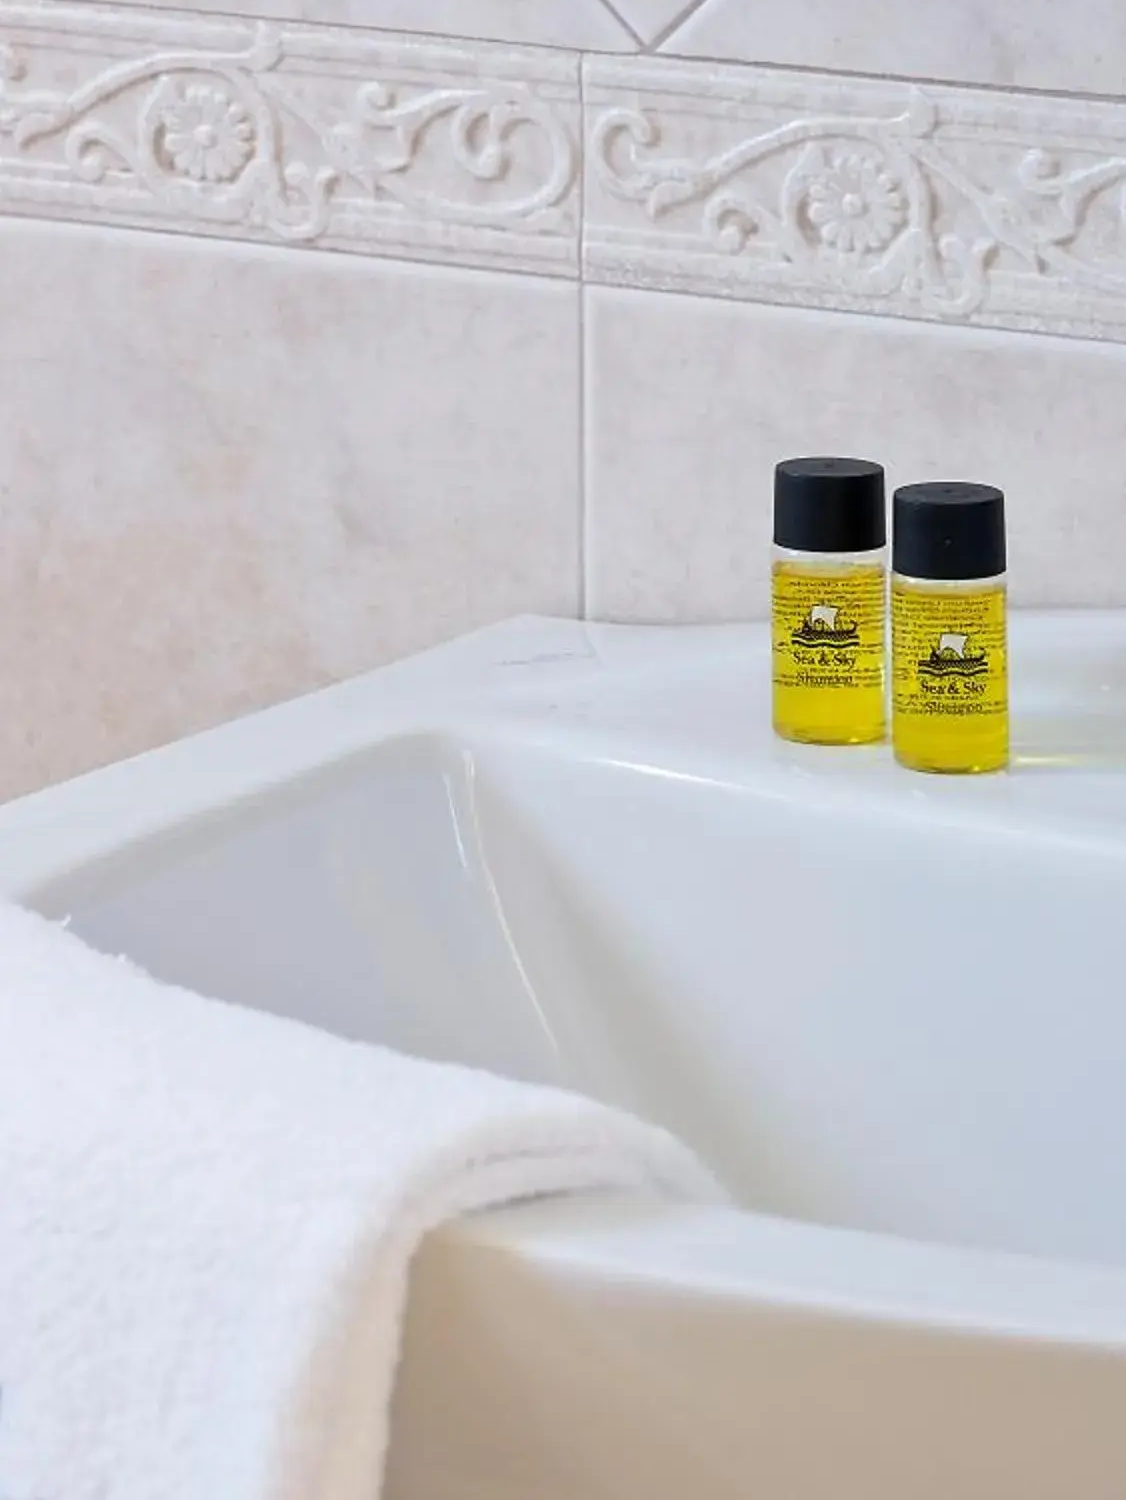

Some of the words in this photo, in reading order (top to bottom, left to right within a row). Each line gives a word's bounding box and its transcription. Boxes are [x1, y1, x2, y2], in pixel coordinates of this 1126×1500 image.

[793, 651, 815, 665] Sea
[817, 653, 831, 665] &
[832, 652, 857, 668] Sky
[920, 681, 945, 694] Sea
[947, 682, 960, 694] &
[962, 681, 987, 697] Sky
